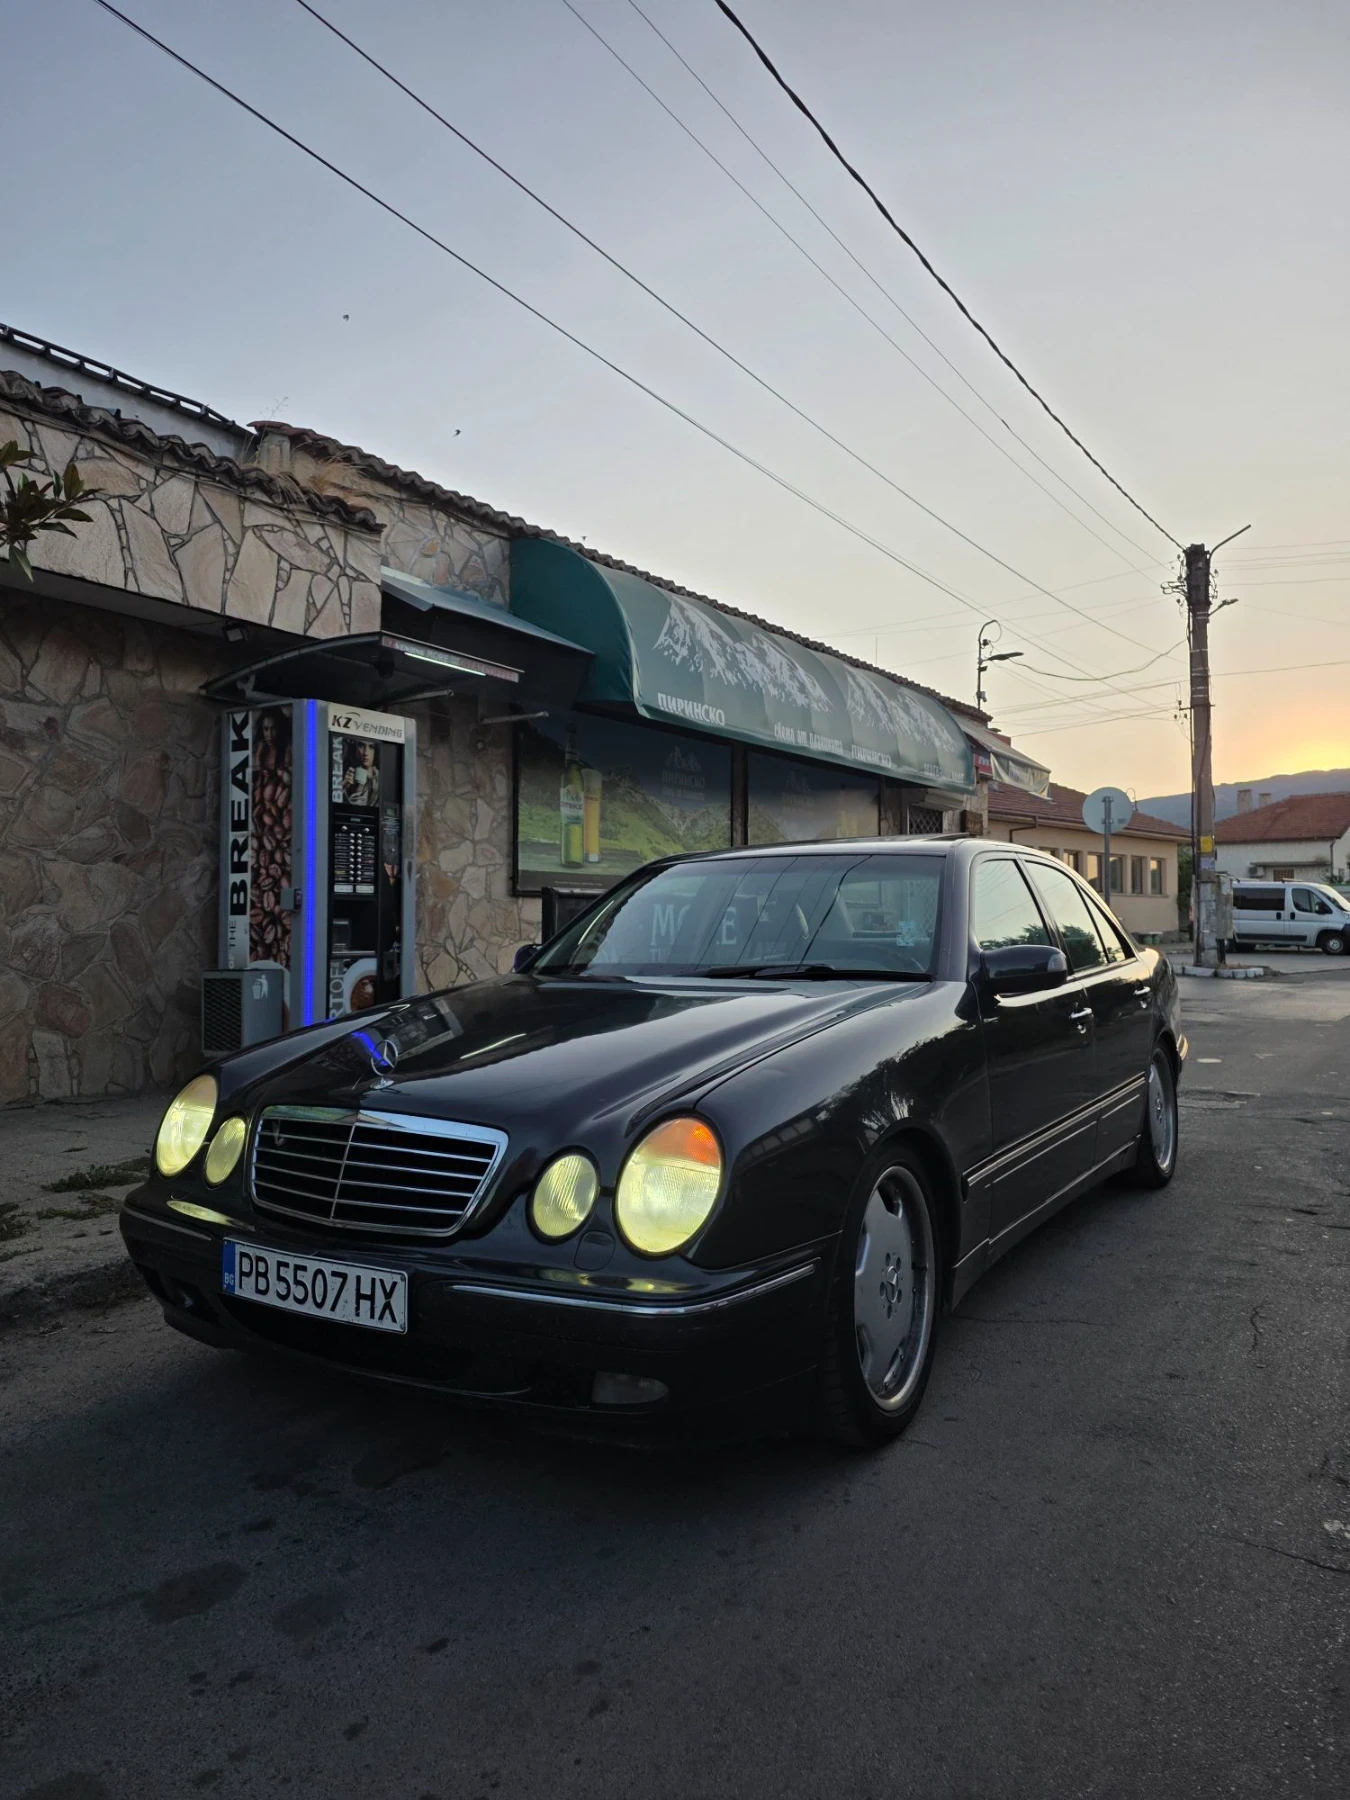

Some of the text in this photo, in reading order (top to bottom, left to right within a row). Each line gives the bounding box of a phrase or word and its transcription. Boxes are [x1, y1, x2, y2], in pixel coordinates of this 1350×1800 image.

[657, 692, 726, 726] ПИРИНСКО
[331, 714, 403, 738] KZ VENDING
[331, 736, 344, 803] BREAK
[229, 711, 249, 916] BREAK
[228, 920, 236, 949] THE
[224, 1272, 235, 1286] BG
